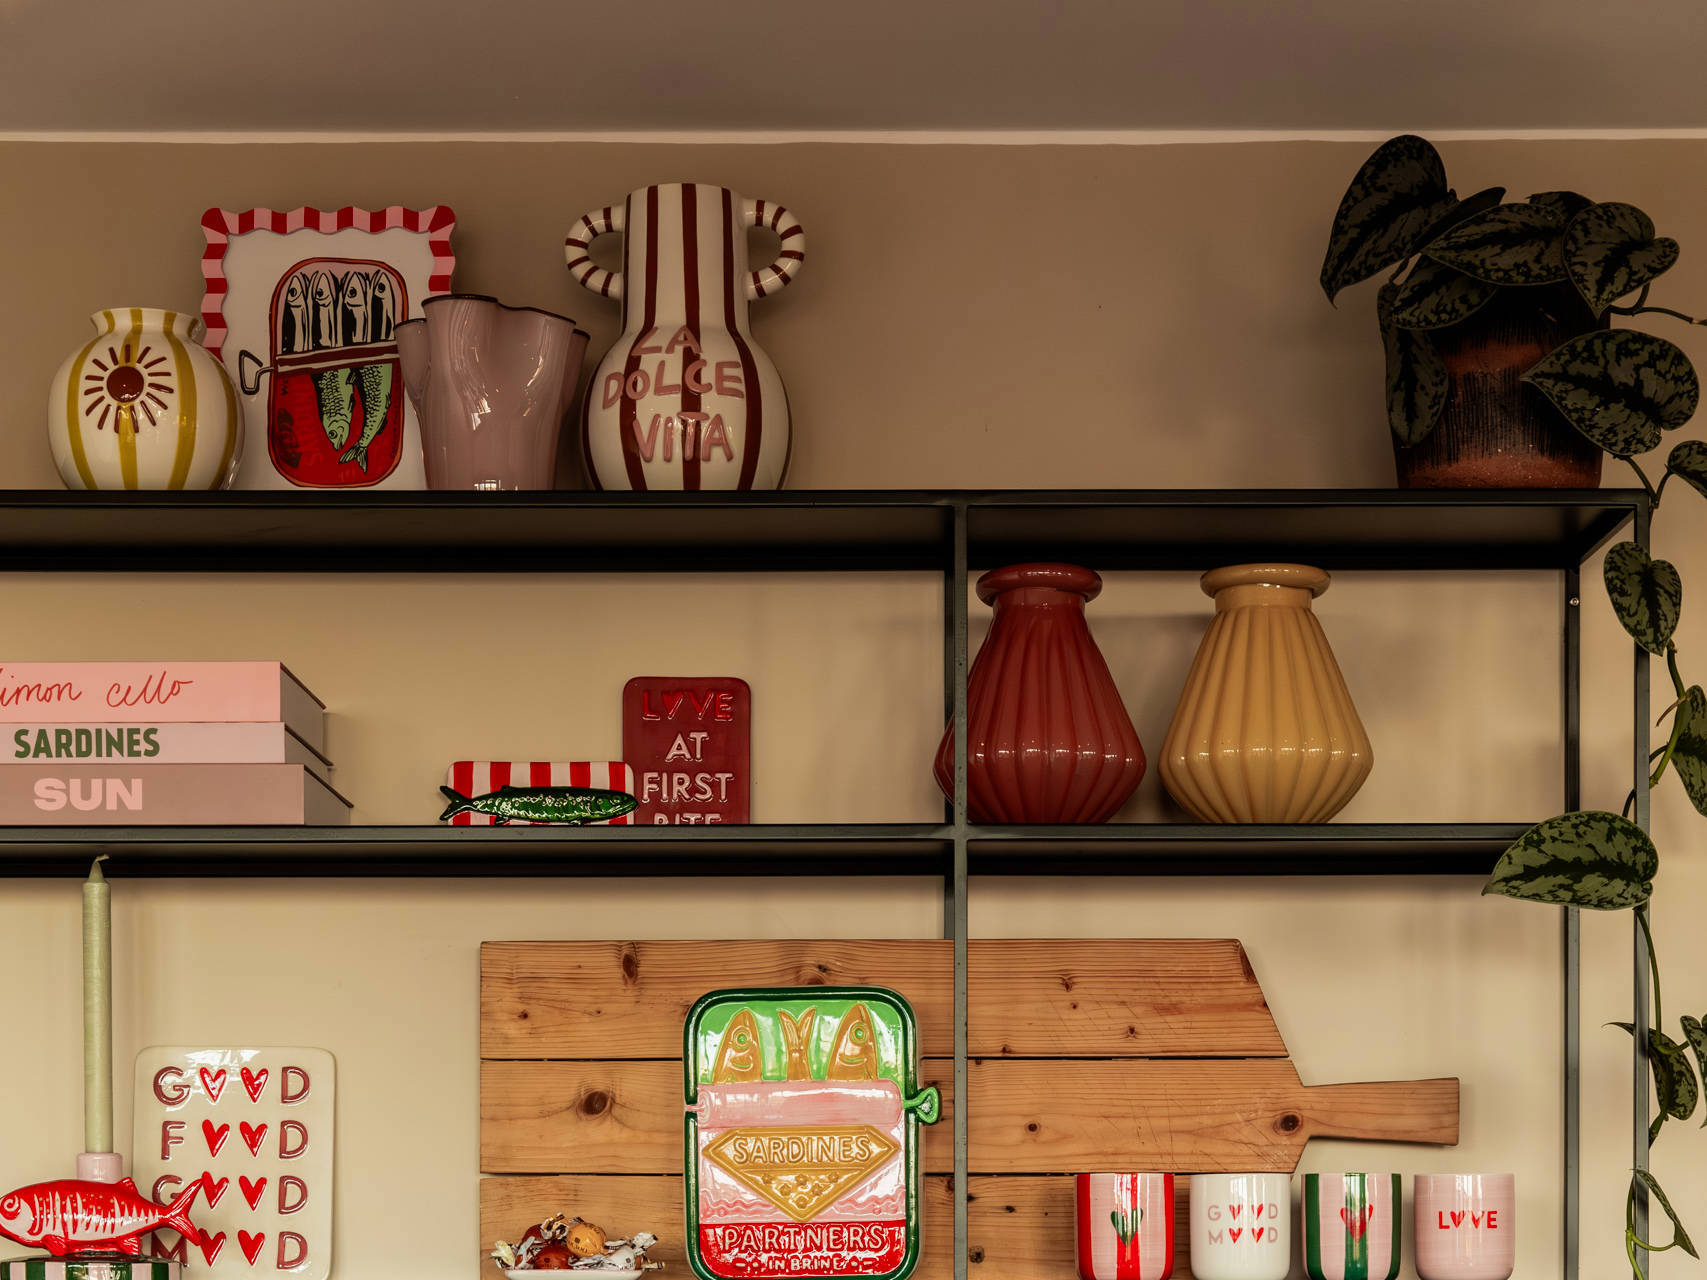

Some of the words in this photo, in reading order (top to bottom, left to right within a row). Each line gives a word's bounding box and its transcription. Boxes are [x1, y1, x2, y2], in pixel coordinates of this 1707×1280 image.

[631, 325, 703, 356] LA
[603, 359, 744, 410] DOLCE
[632, 411, 734, 463] VITA
[0, 667, 83, 707] imon
[106, 670, 194, 708] cello
[13, 727, 161, 759] SARDINES
[664, 731, 710, 763] AT
[33, 777, 144, 812] SUN
[641, 771, 735, 804] FIRST
[732, 1135, 873, 1165] SARDINES
[724, 1225, 884, 1251] PARTNERS
[768, 1256, 786, 1270] IN
[790, 1255, 844, 1271] BRINE
